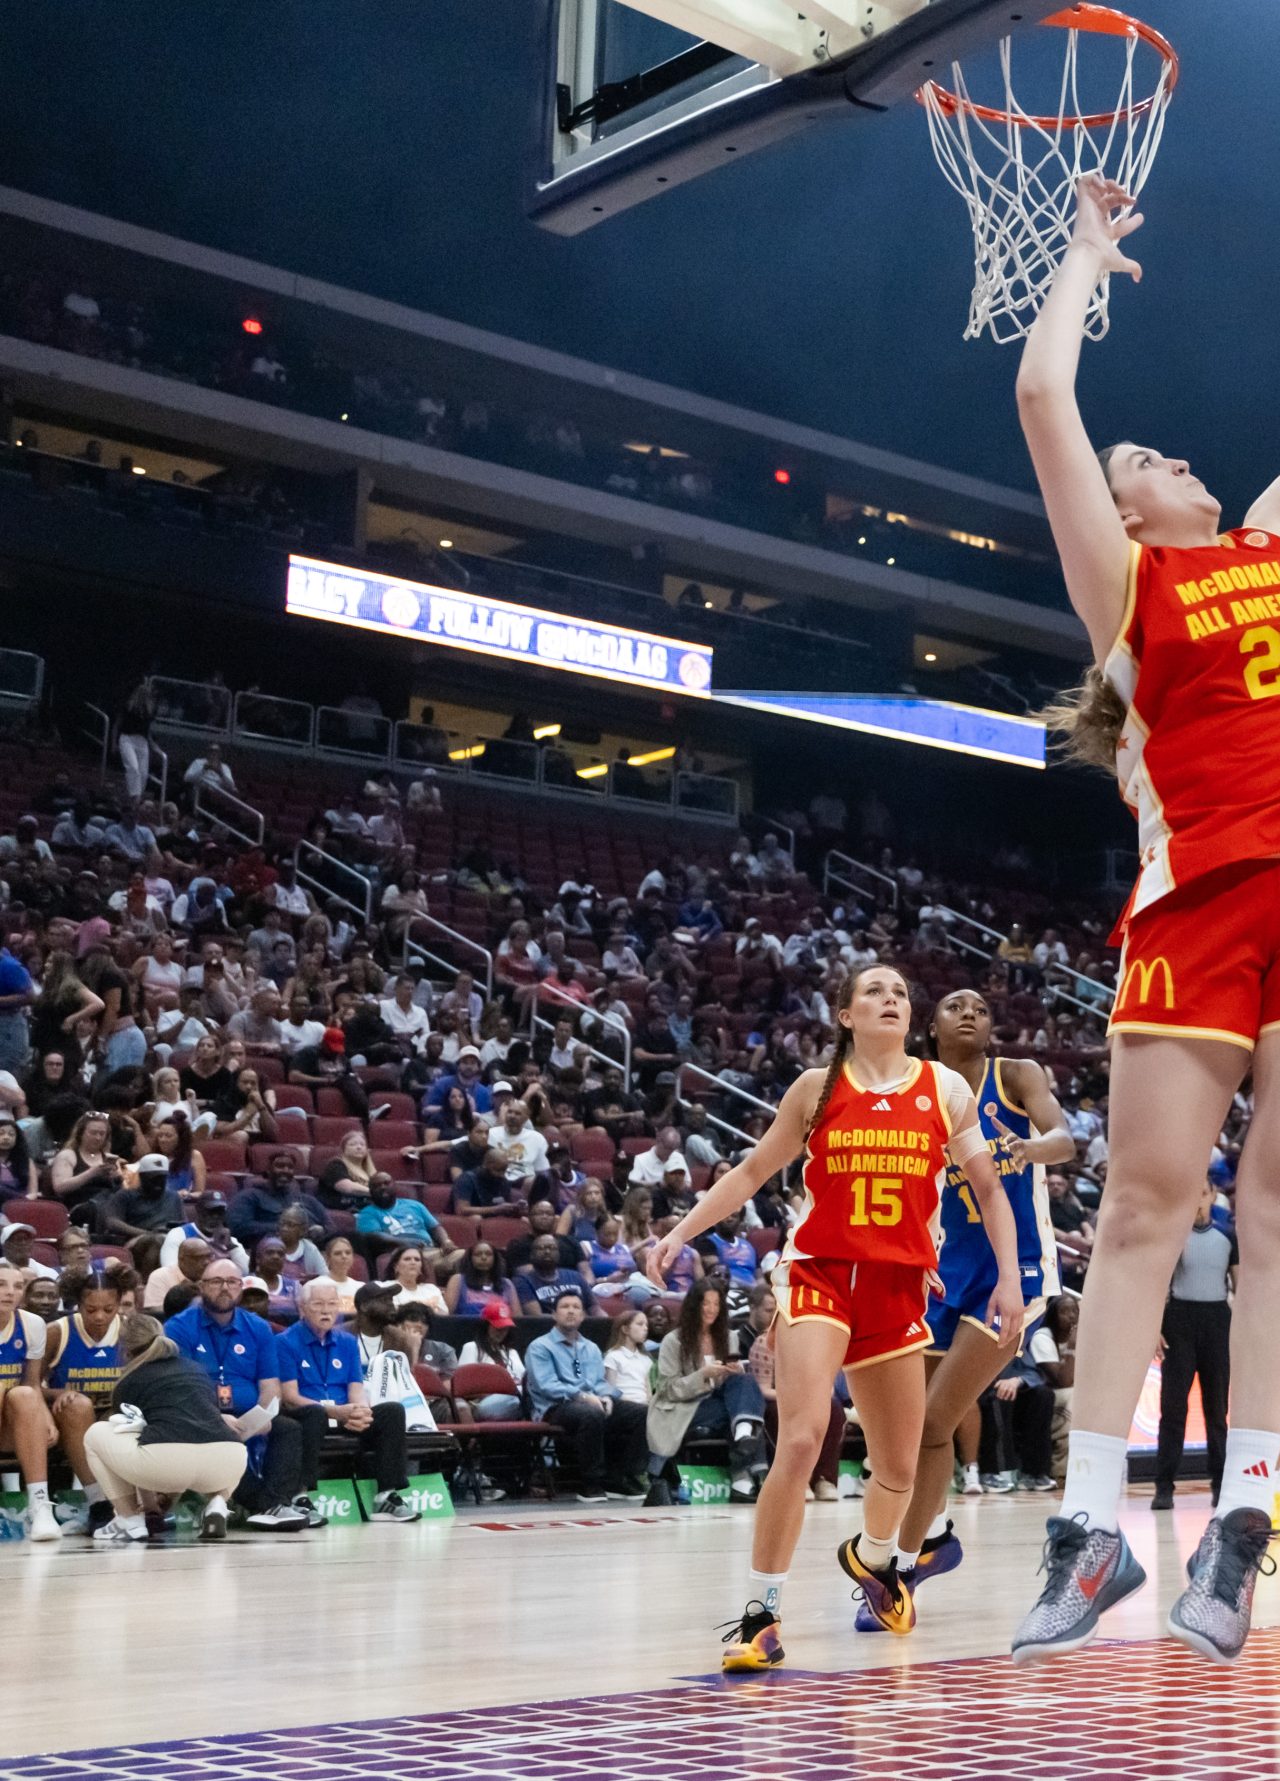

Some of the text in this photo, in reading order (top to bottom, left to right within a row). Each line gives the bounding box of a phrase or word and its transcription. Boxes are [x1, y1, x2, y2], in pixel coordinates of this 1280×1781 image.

[428, 596, 534, 651] FOLLOW
[1185, 606, 1231, 640] ALL
[827, 1129, 930, 1152] McDONALD'S
[850, 1154, 930, 1177] AMERICAN
[849, 1177, 903, 1226] 15
[692, 1477, 731, 1503] Spri
